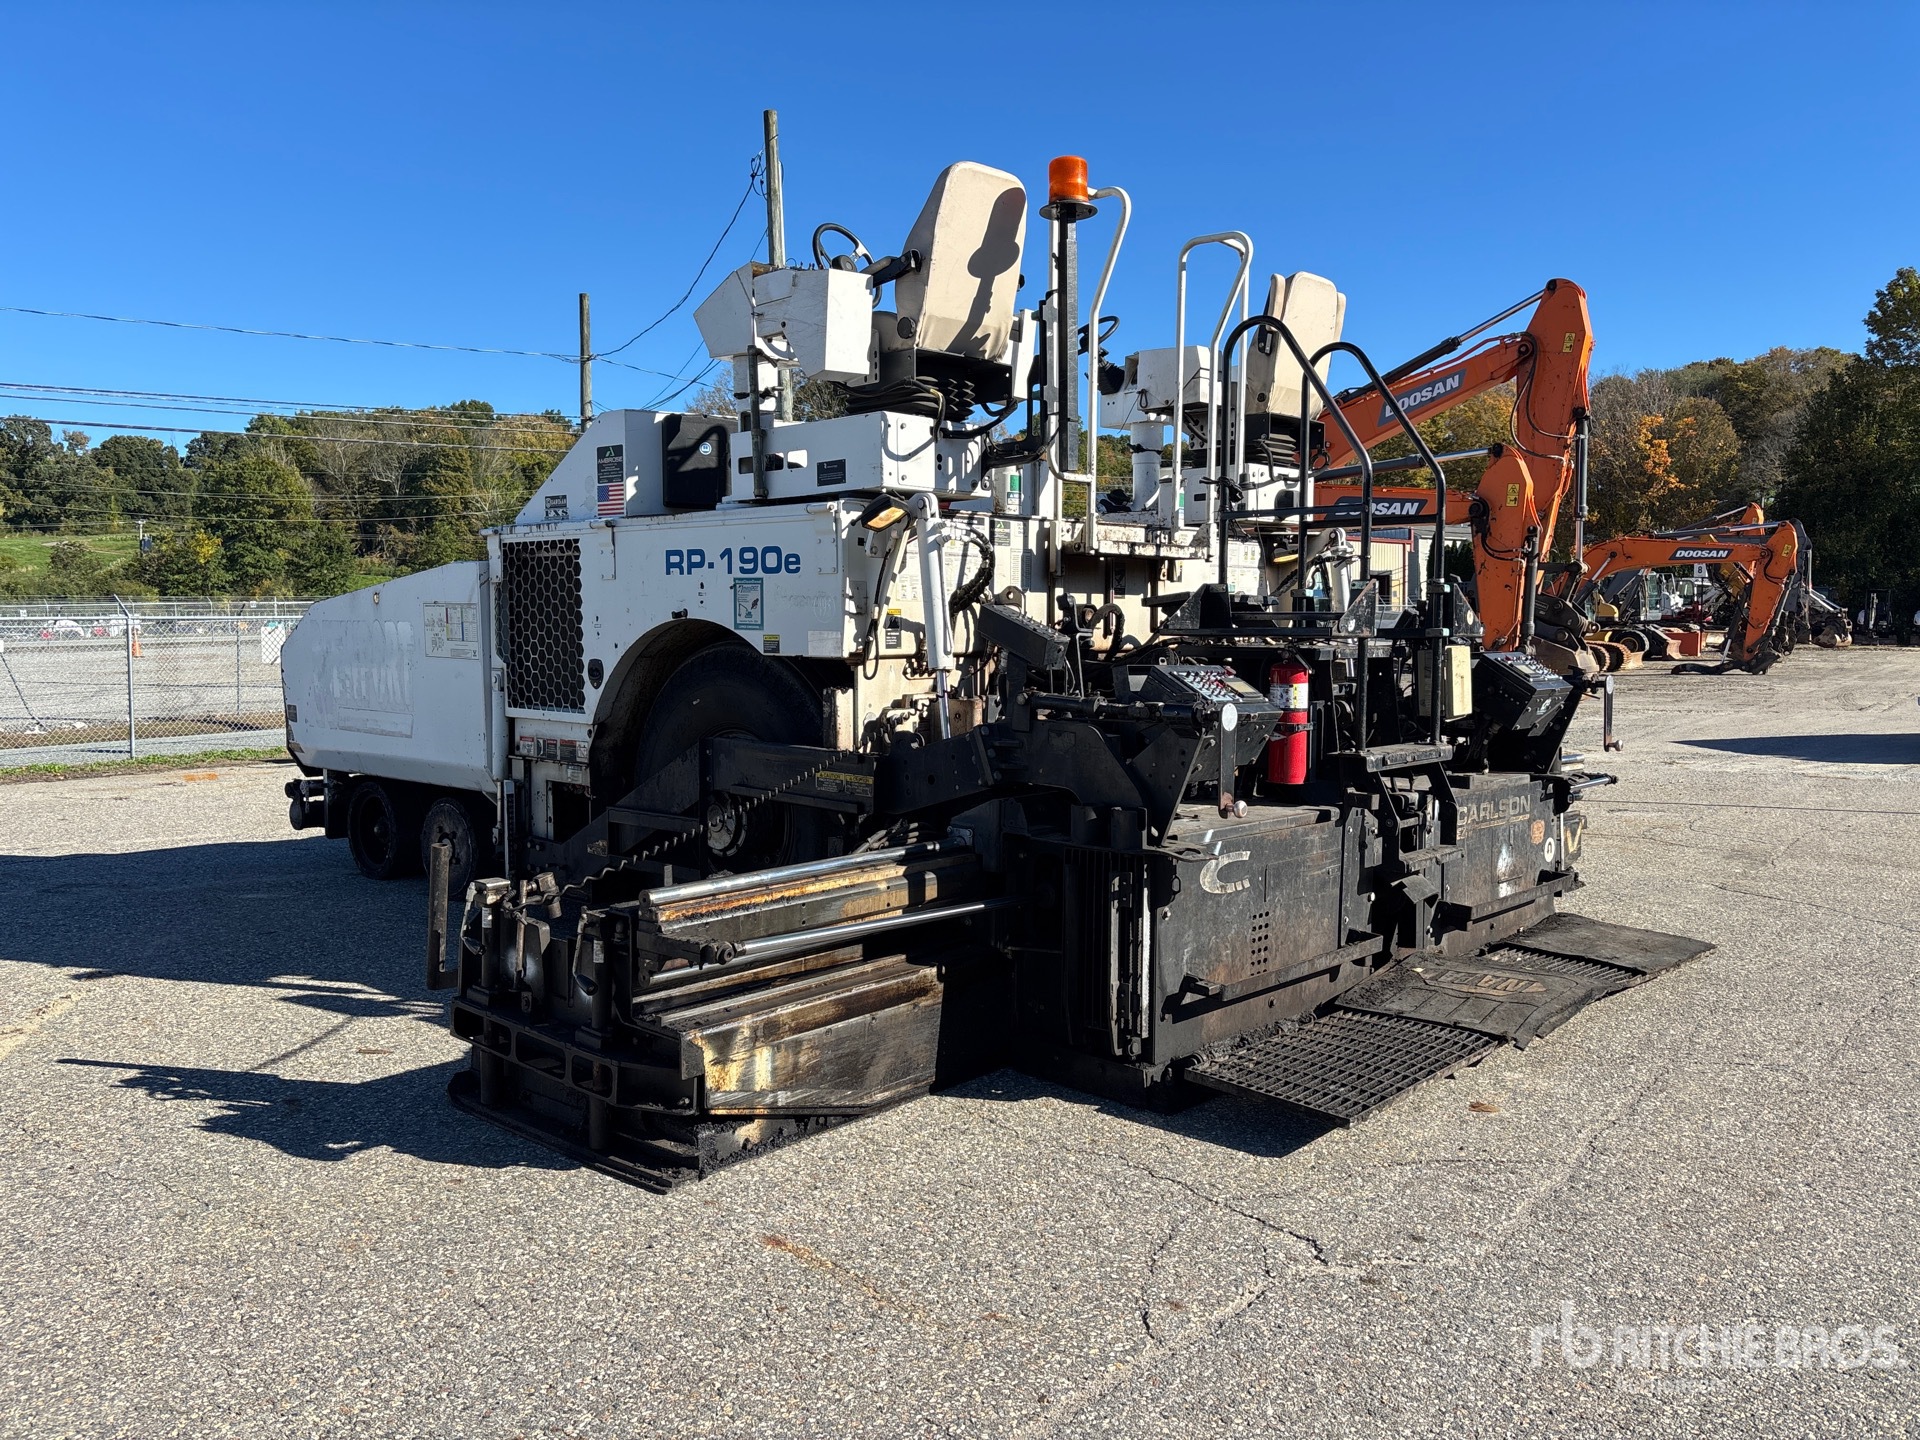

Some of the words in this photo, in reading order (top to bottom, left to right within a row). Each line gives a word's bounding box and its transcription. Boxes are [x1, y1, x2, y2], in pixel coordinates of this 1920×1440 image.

[665, 546, 801, 575] RP-190e
[1675, 550, 1729, 558] DOOSAN
[1697, 566, 1703, 574] 8
[1457, 795, 1531, 826] CARLSON
